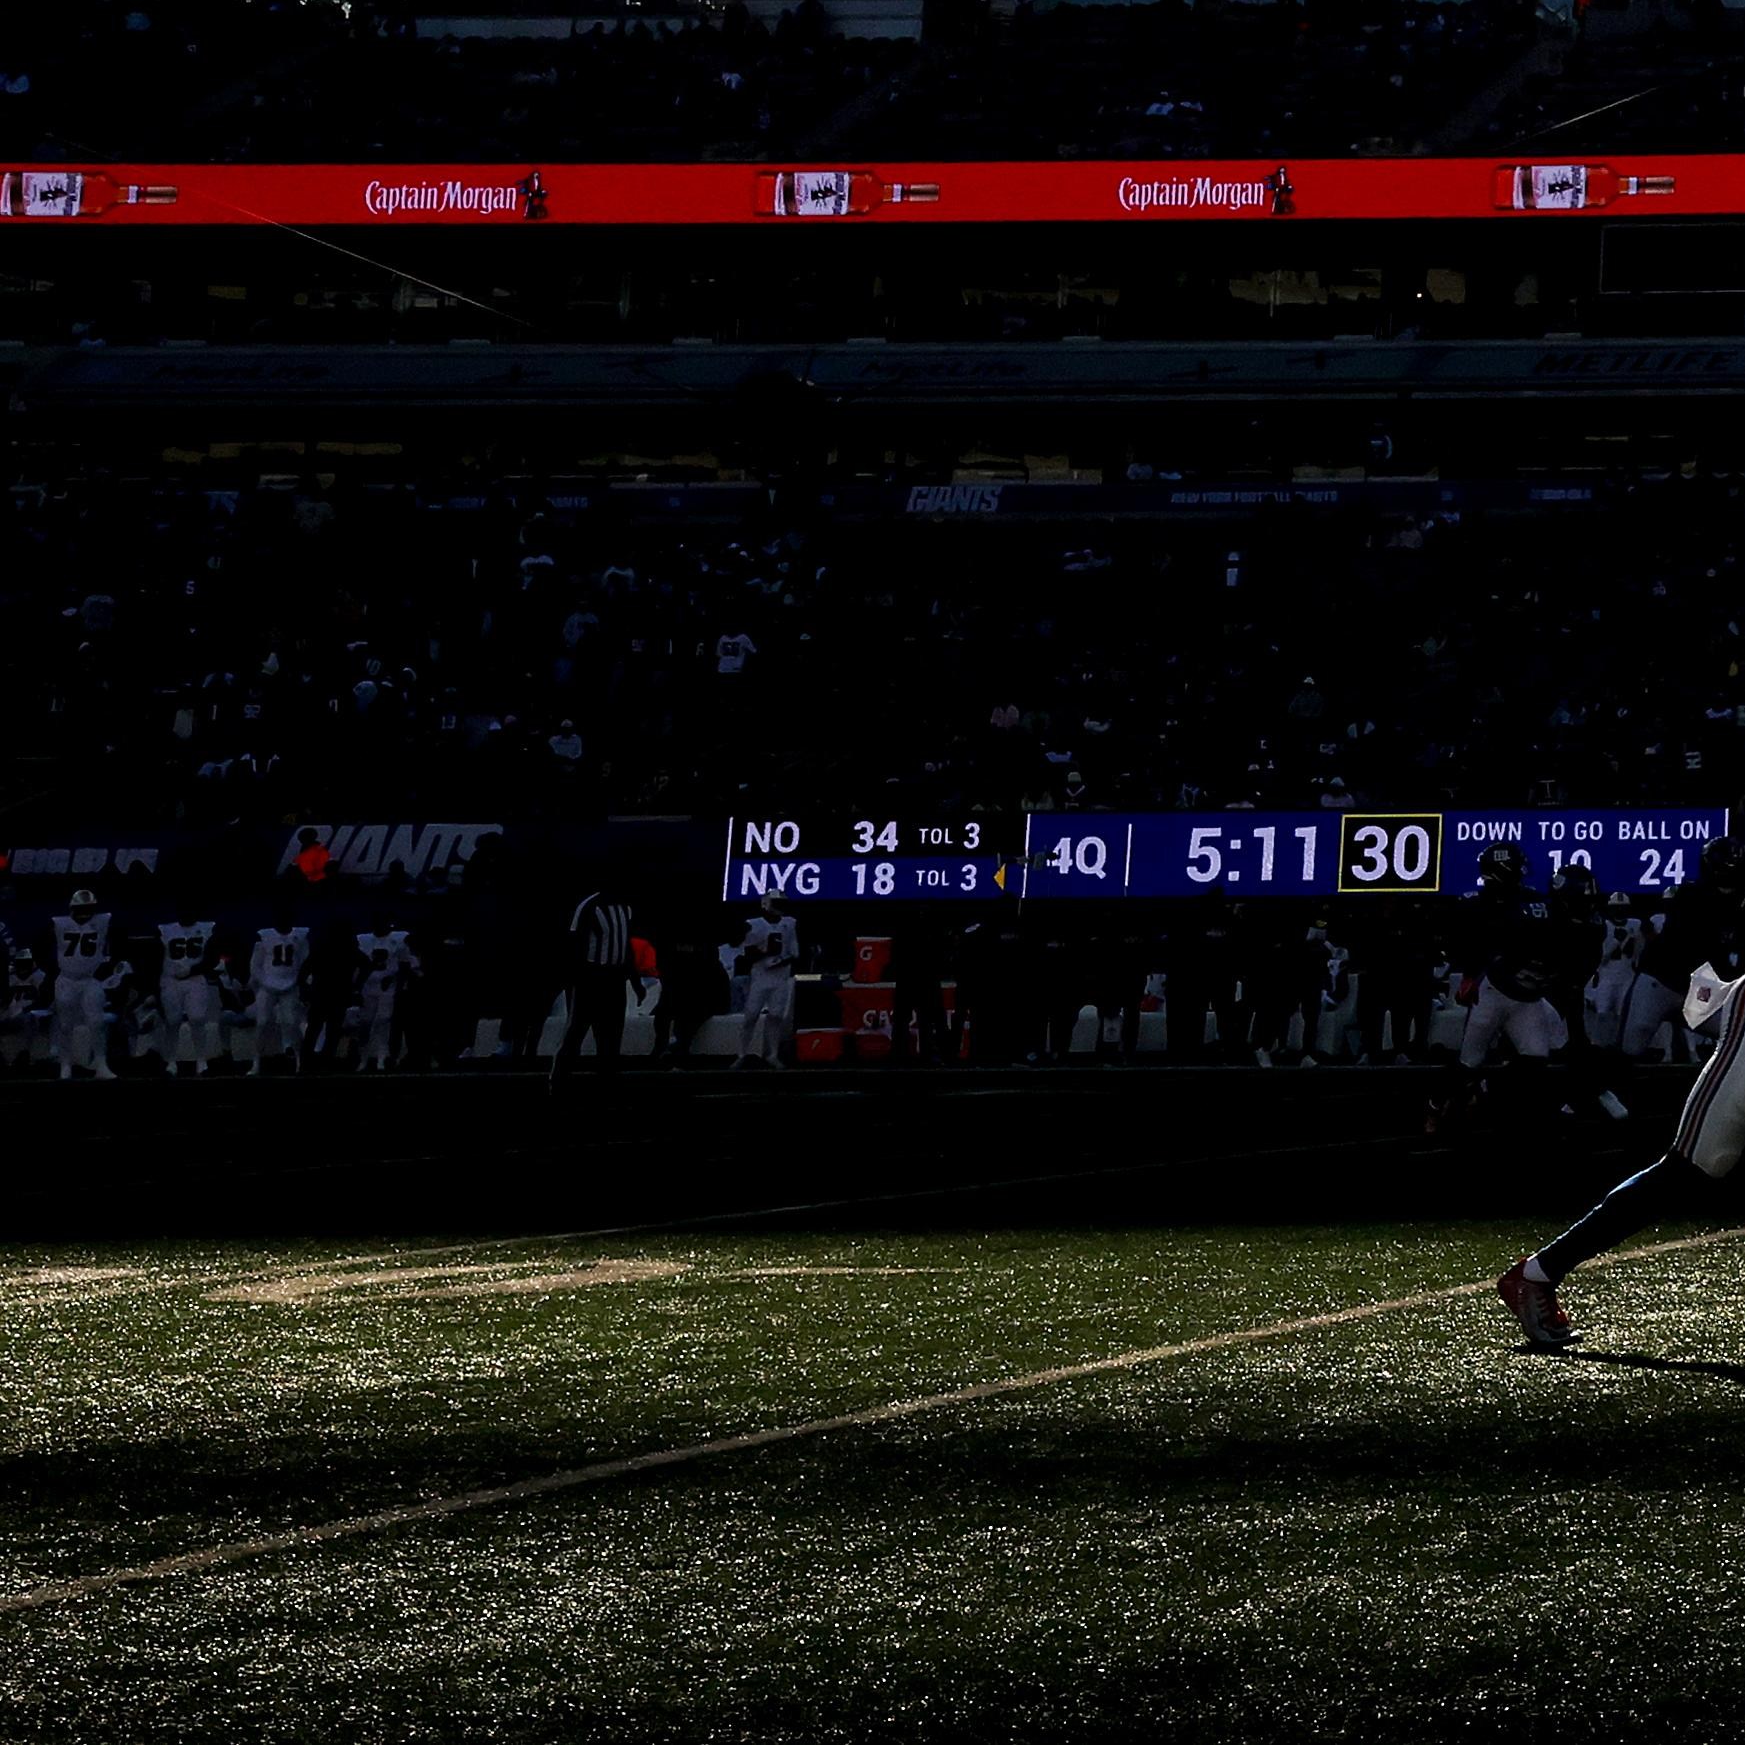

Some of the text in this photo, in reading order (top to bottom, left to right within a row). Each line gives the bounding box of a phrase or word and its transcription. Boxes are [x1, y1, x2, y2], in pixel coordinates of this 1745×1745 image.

[366, 181, 516, 215] Captain Morgan
[1119, 177, 1264, 211] Captain Morgan
[1534, 350, 1732, 373] METLIFE
[905, 485, 1001, 516] GIANTS
[1236, 492, 1292, 504] FOOTALL
[744, 820, 981, 854] NO 34 TOL 3
[1457, 819, 1711, 842] DOWN TO GO BALL ON
[1052, 836, 1108, 879] 4Q
[1187, 825, 1318, 883] 5:11
[1351, 825, 1431, 882] 30
[1638, 848, 1688, 887] 24
[740, 862, 978, 897] NYG 18 TOL 3
[63, 932, 98, 958] 76
